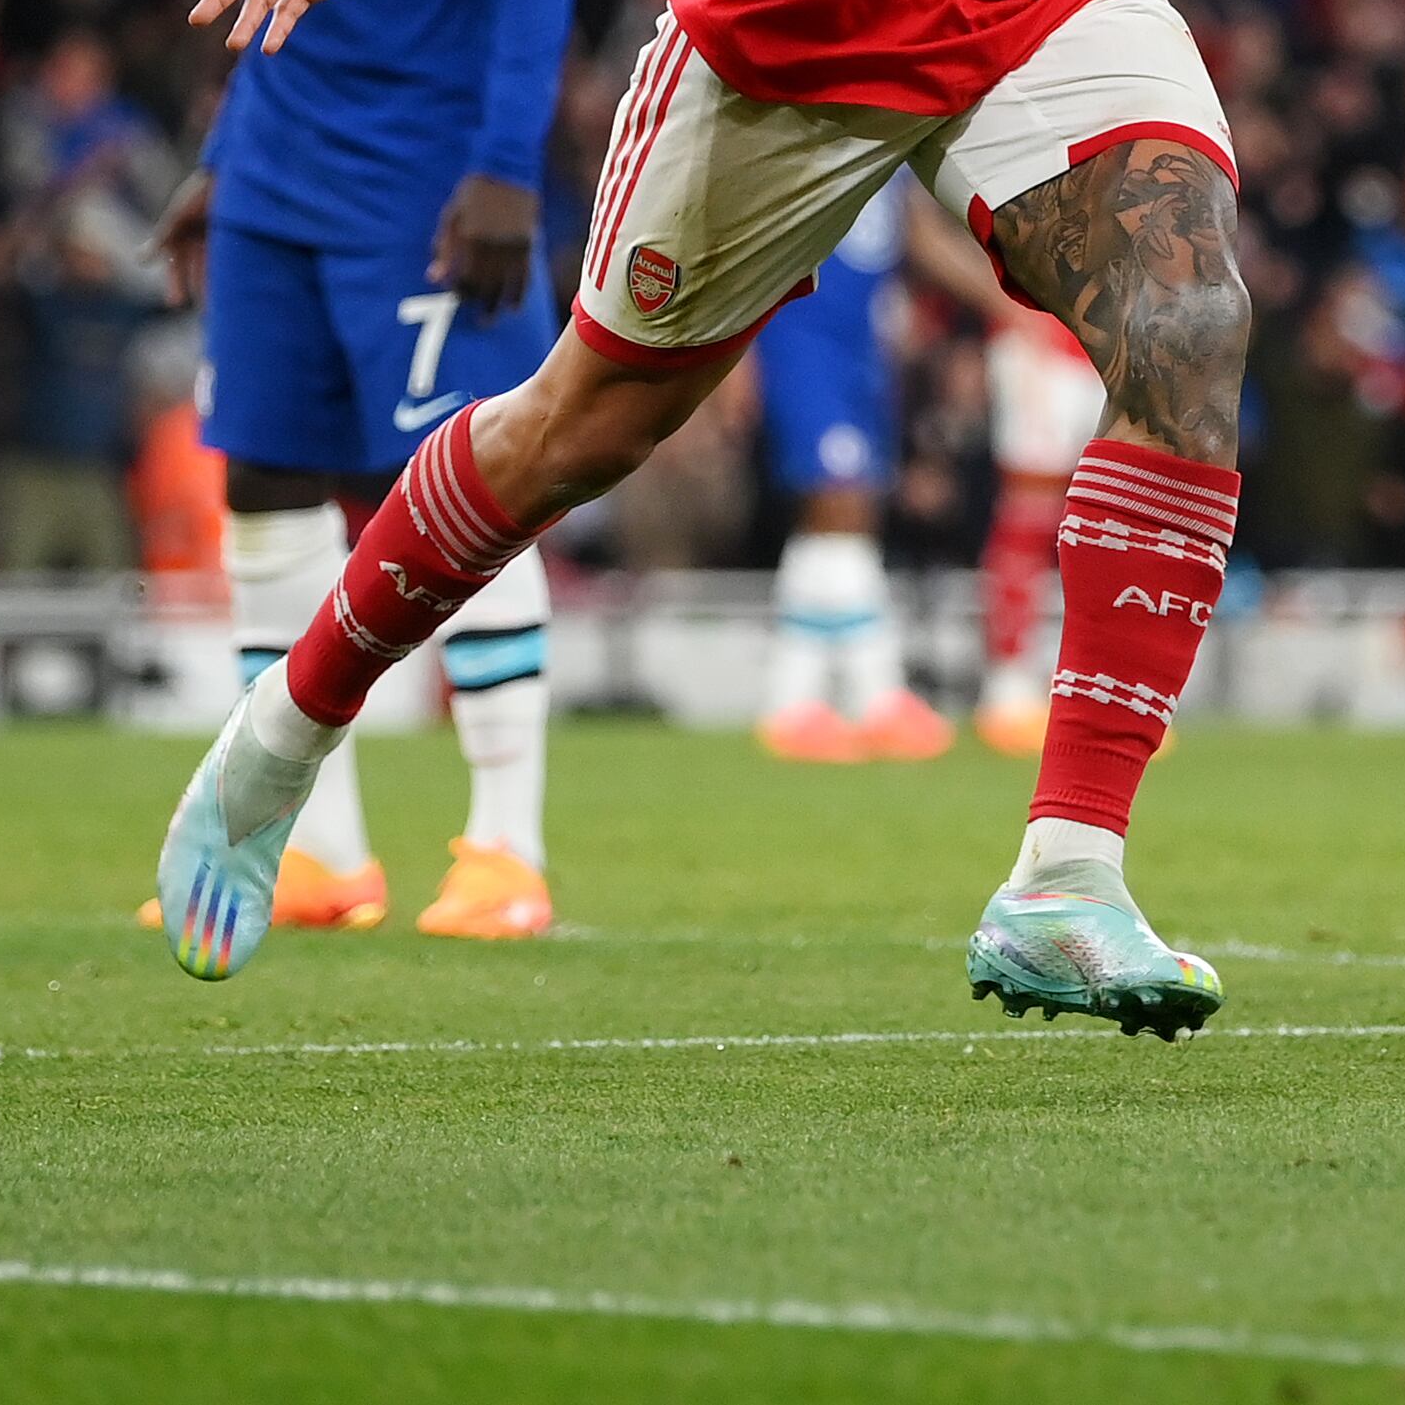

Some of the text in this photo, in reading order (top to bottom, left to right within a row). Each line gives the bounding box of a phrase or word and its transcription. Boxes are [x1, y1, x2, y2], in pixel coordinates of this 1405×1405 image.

[636, 256, 673, 279] Arsenal
[397, 291, 460, 397] 7
[1113, 585, 1213, 627] AFC
